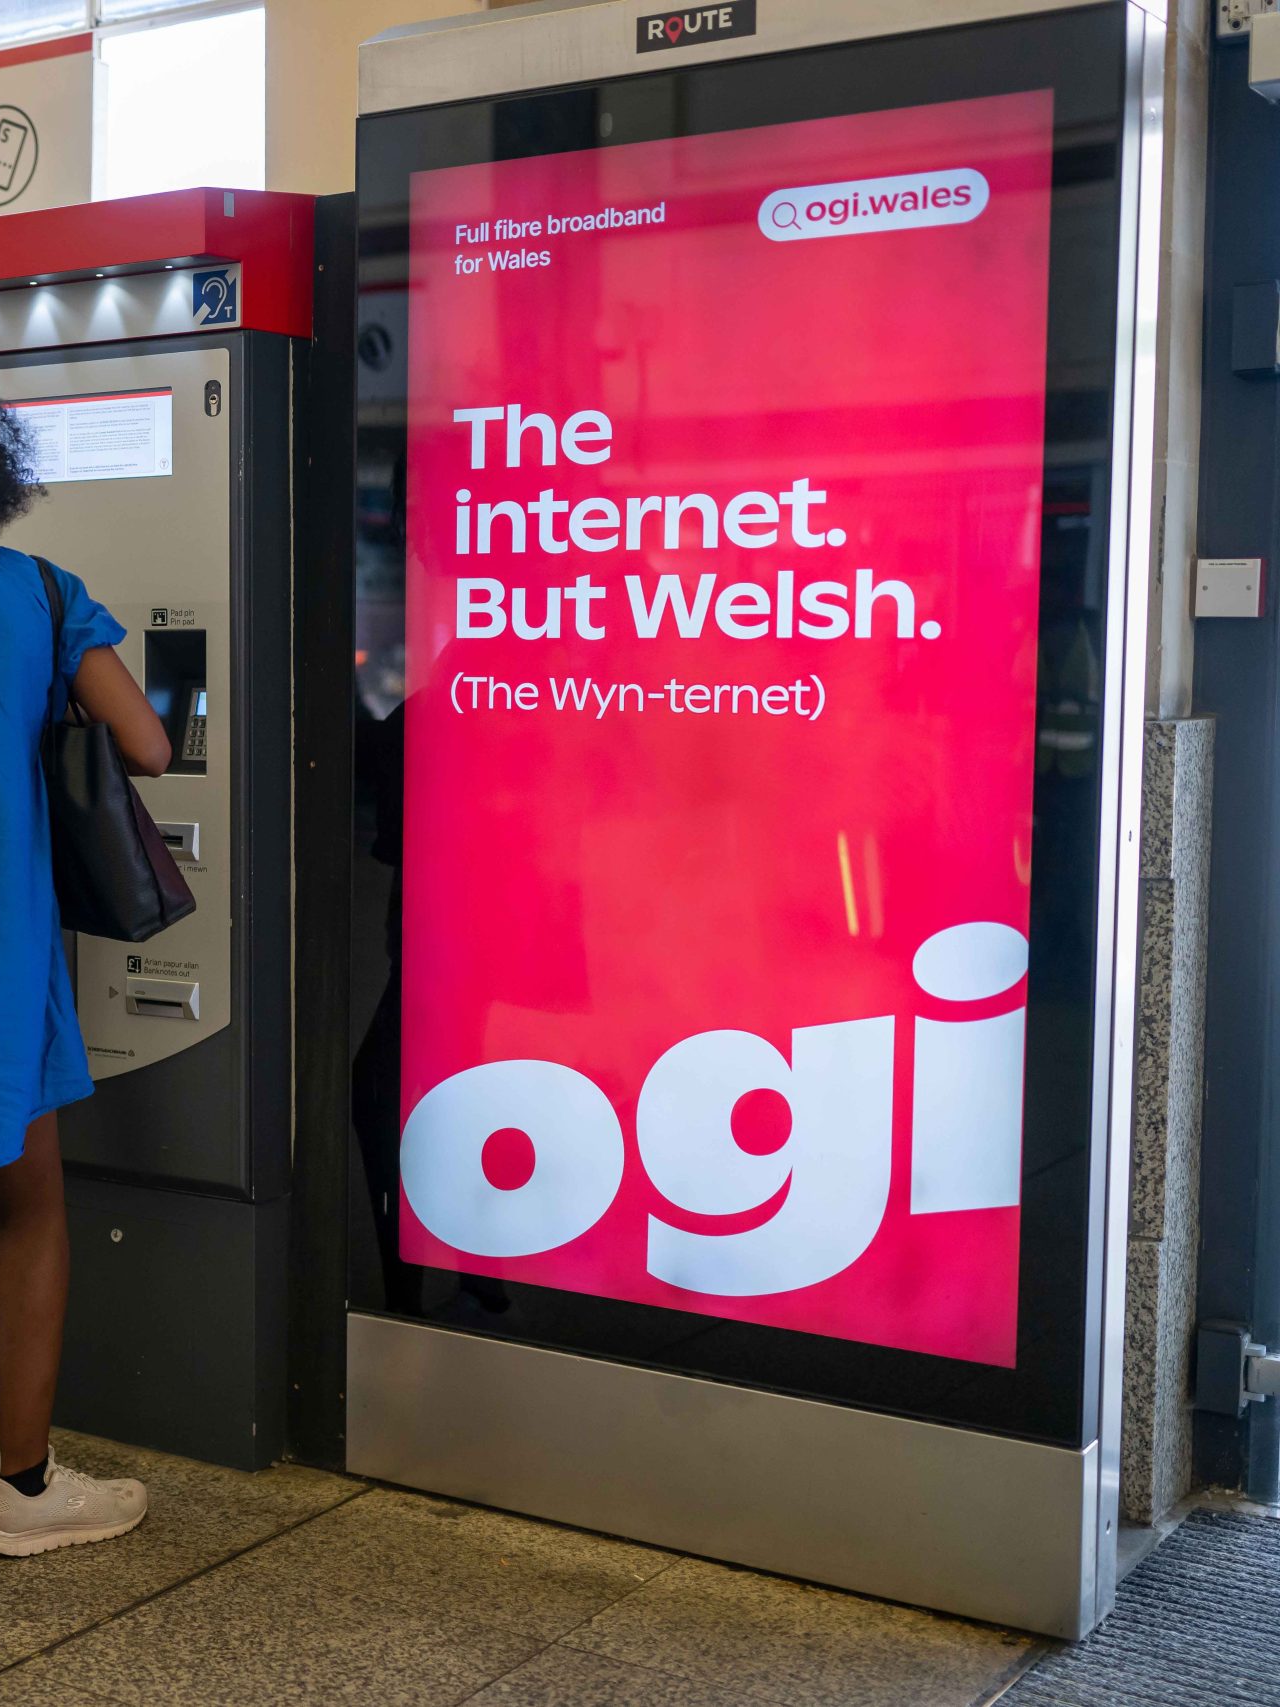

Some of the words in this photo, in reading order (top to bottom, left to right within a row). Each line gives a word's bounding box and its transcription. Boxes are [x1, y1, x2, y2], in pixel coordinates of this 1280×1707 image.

[647, 7, 732, 44] ROUTE
[455, 222, 490, 245] Full
[493, 216, 542, 240] fibre
[547, 202, 666, 234] broadband
[805, 183, 972, 224] ogi.wales
[454, 253, 484, 274] for
[487, 248, 551, 271] Wales
[452, 403, 613, 469] The
[455, 477, 847, 555] internet.
[455, 575, 607, 641] But
[624, 568, 942, 640] Welsh.
[450, 671, 539, 714] (The
[549, 674, 826, 721] Wyn-ternet)
[178, 969, 191, 978] out
[400, 921, 1030, 1296] ogi
